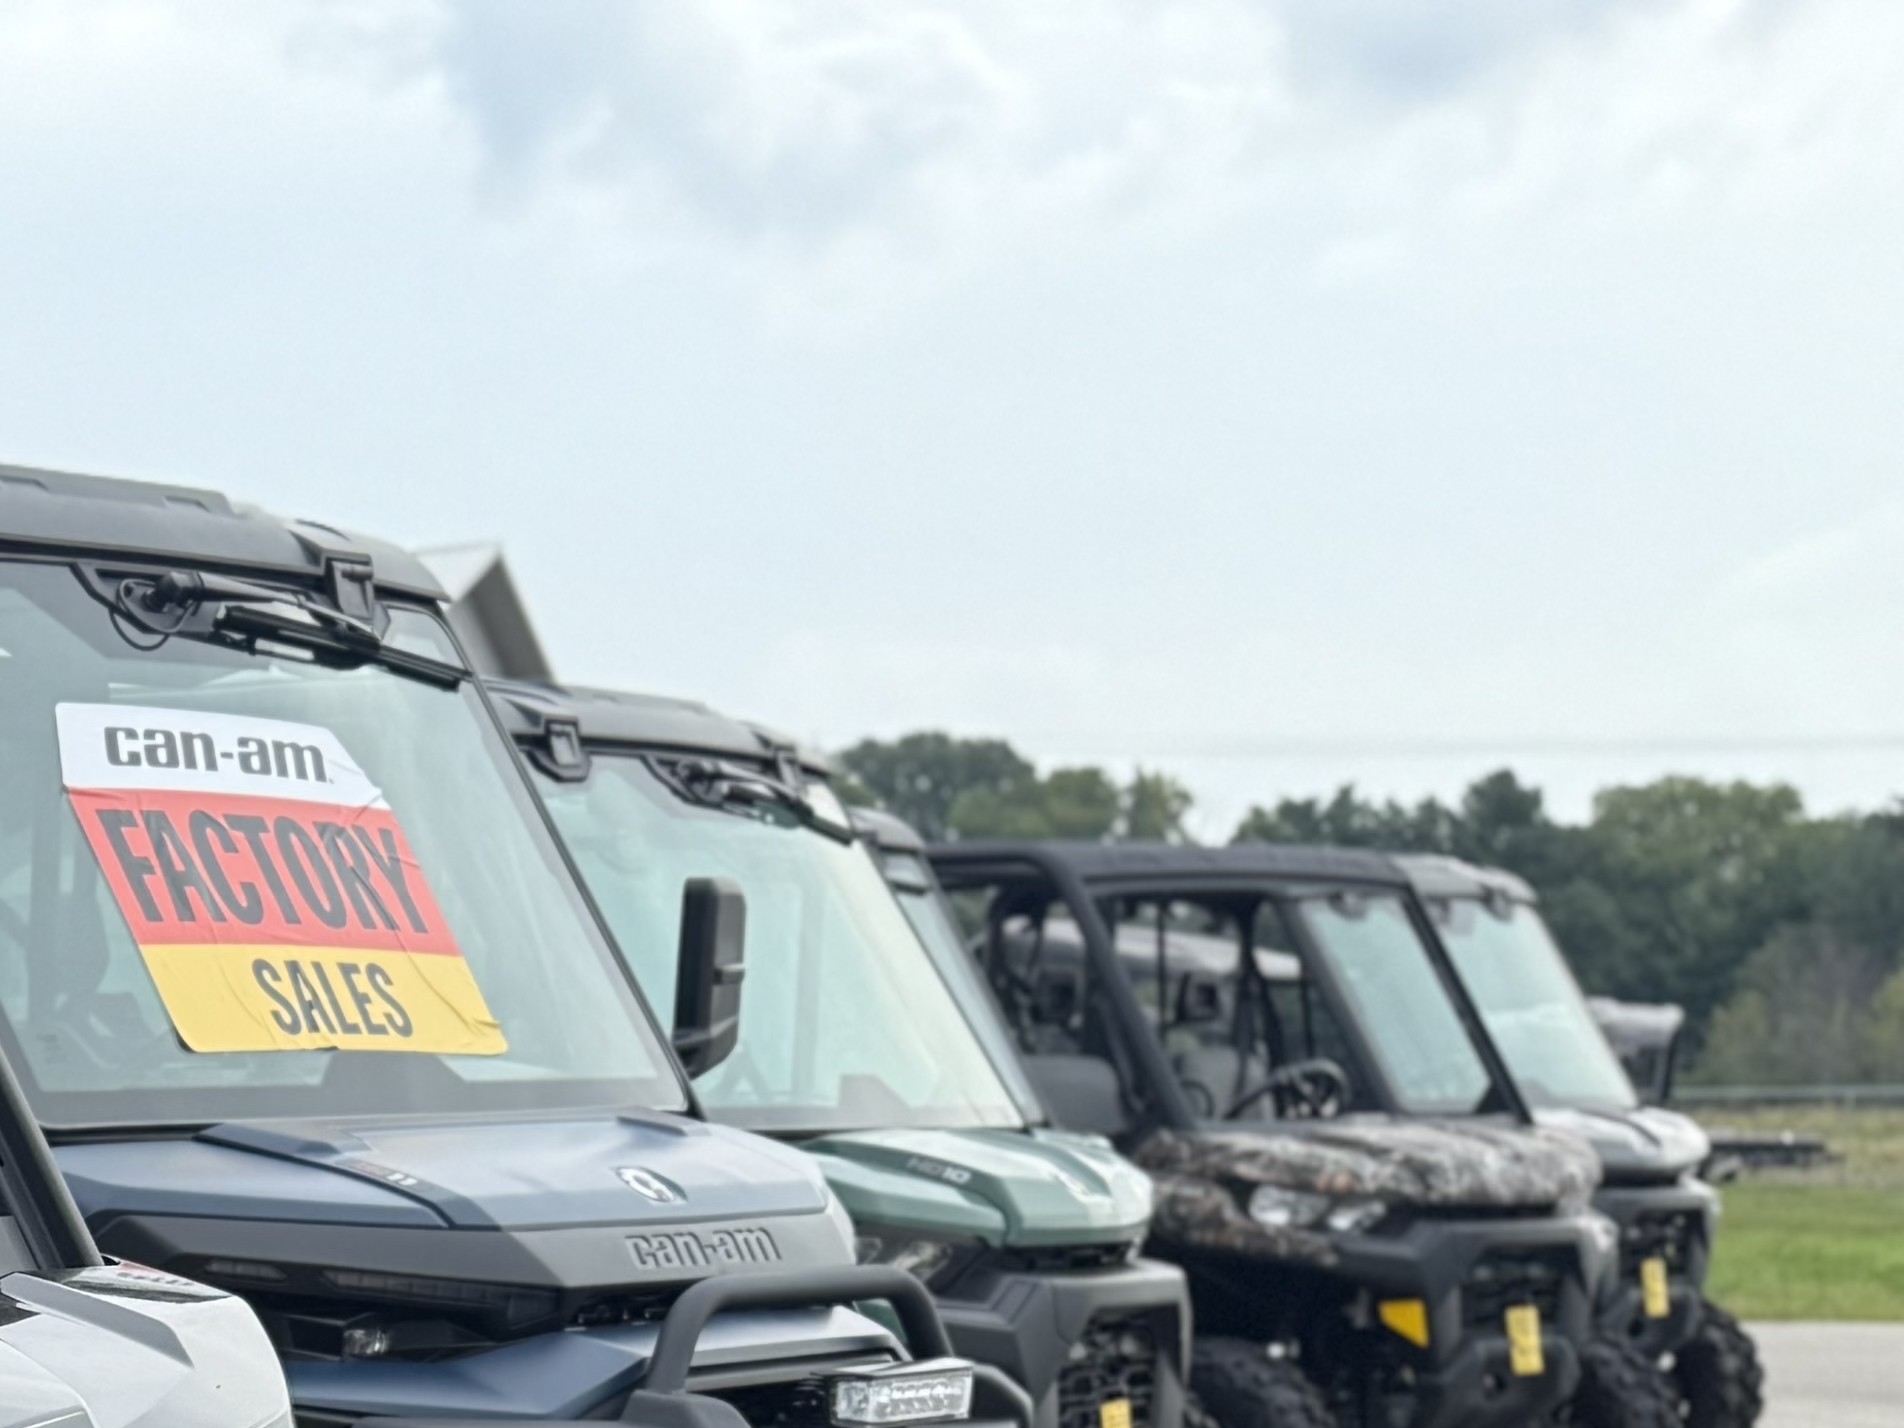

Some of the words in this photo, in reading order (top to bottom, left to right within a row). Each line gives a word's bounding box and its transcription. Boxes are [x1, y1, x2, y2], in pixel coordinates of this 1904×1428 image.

[103, 725, 327, 784] can-am
[95, 808, 430, 935] FACTORY
[250, 957, 414, 1039] SALES
[625, 1226, 783, 1270] can-am
